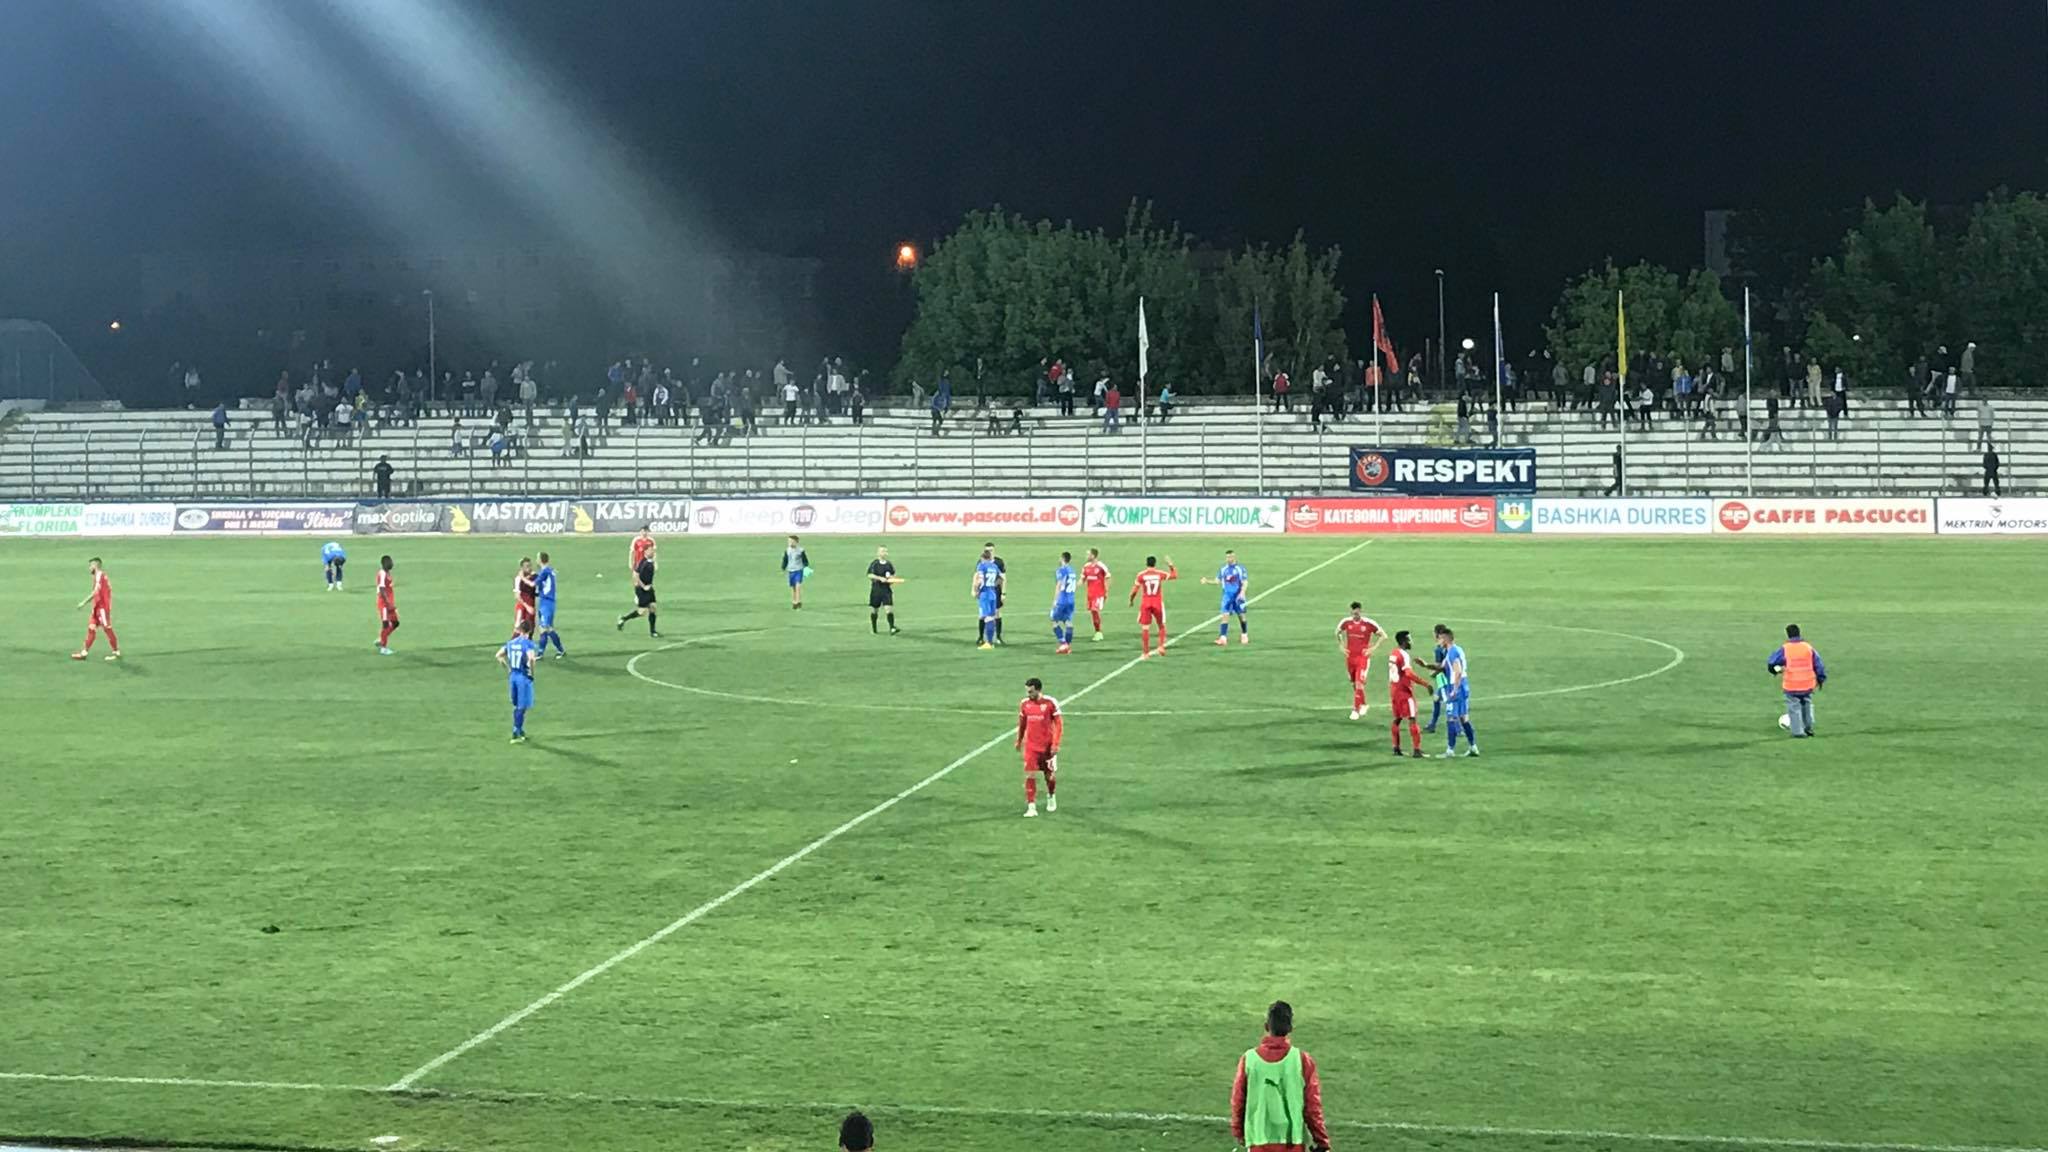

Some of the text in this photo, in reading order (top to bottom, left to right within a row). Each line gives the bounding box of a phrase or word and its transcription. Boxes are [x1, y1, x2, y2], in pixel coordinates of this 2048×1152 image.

[1394, 459, 1532, 482] RESPEKT
[17, 505, 83, 517] KOMPLEKSI
[357, 509, 435, 526] max optika
[473, 502, 565, 520] KASTRATI
[596, 501, 690, 519] KASTRATI
[825, 506, 882, 526] Jeep
[912, 507, 1056, 526] www.pascucci.al
[1107, 506, 1261, 525] KOMPLEKSI FLORIDA
[1324, 508, 1389, 523] KATEGORIA
[1392, 508, 1457, 523] SUPERIORE
[1538, 507, 1706, 525] BASHKIA DURRES
[1753, 509, 1927, 523] CAFFE PASCUCCI
[19, 521, 78, 532] FLORIDA
[525, 522, 563, 533] GROUP
[649, 521, 688, 532] GROUP
[1944, 520, 2047, 528] MEKTRIN MOTORS
[1145, 580, 1160, 596] 17
[511, 650, 522, 669] 17
